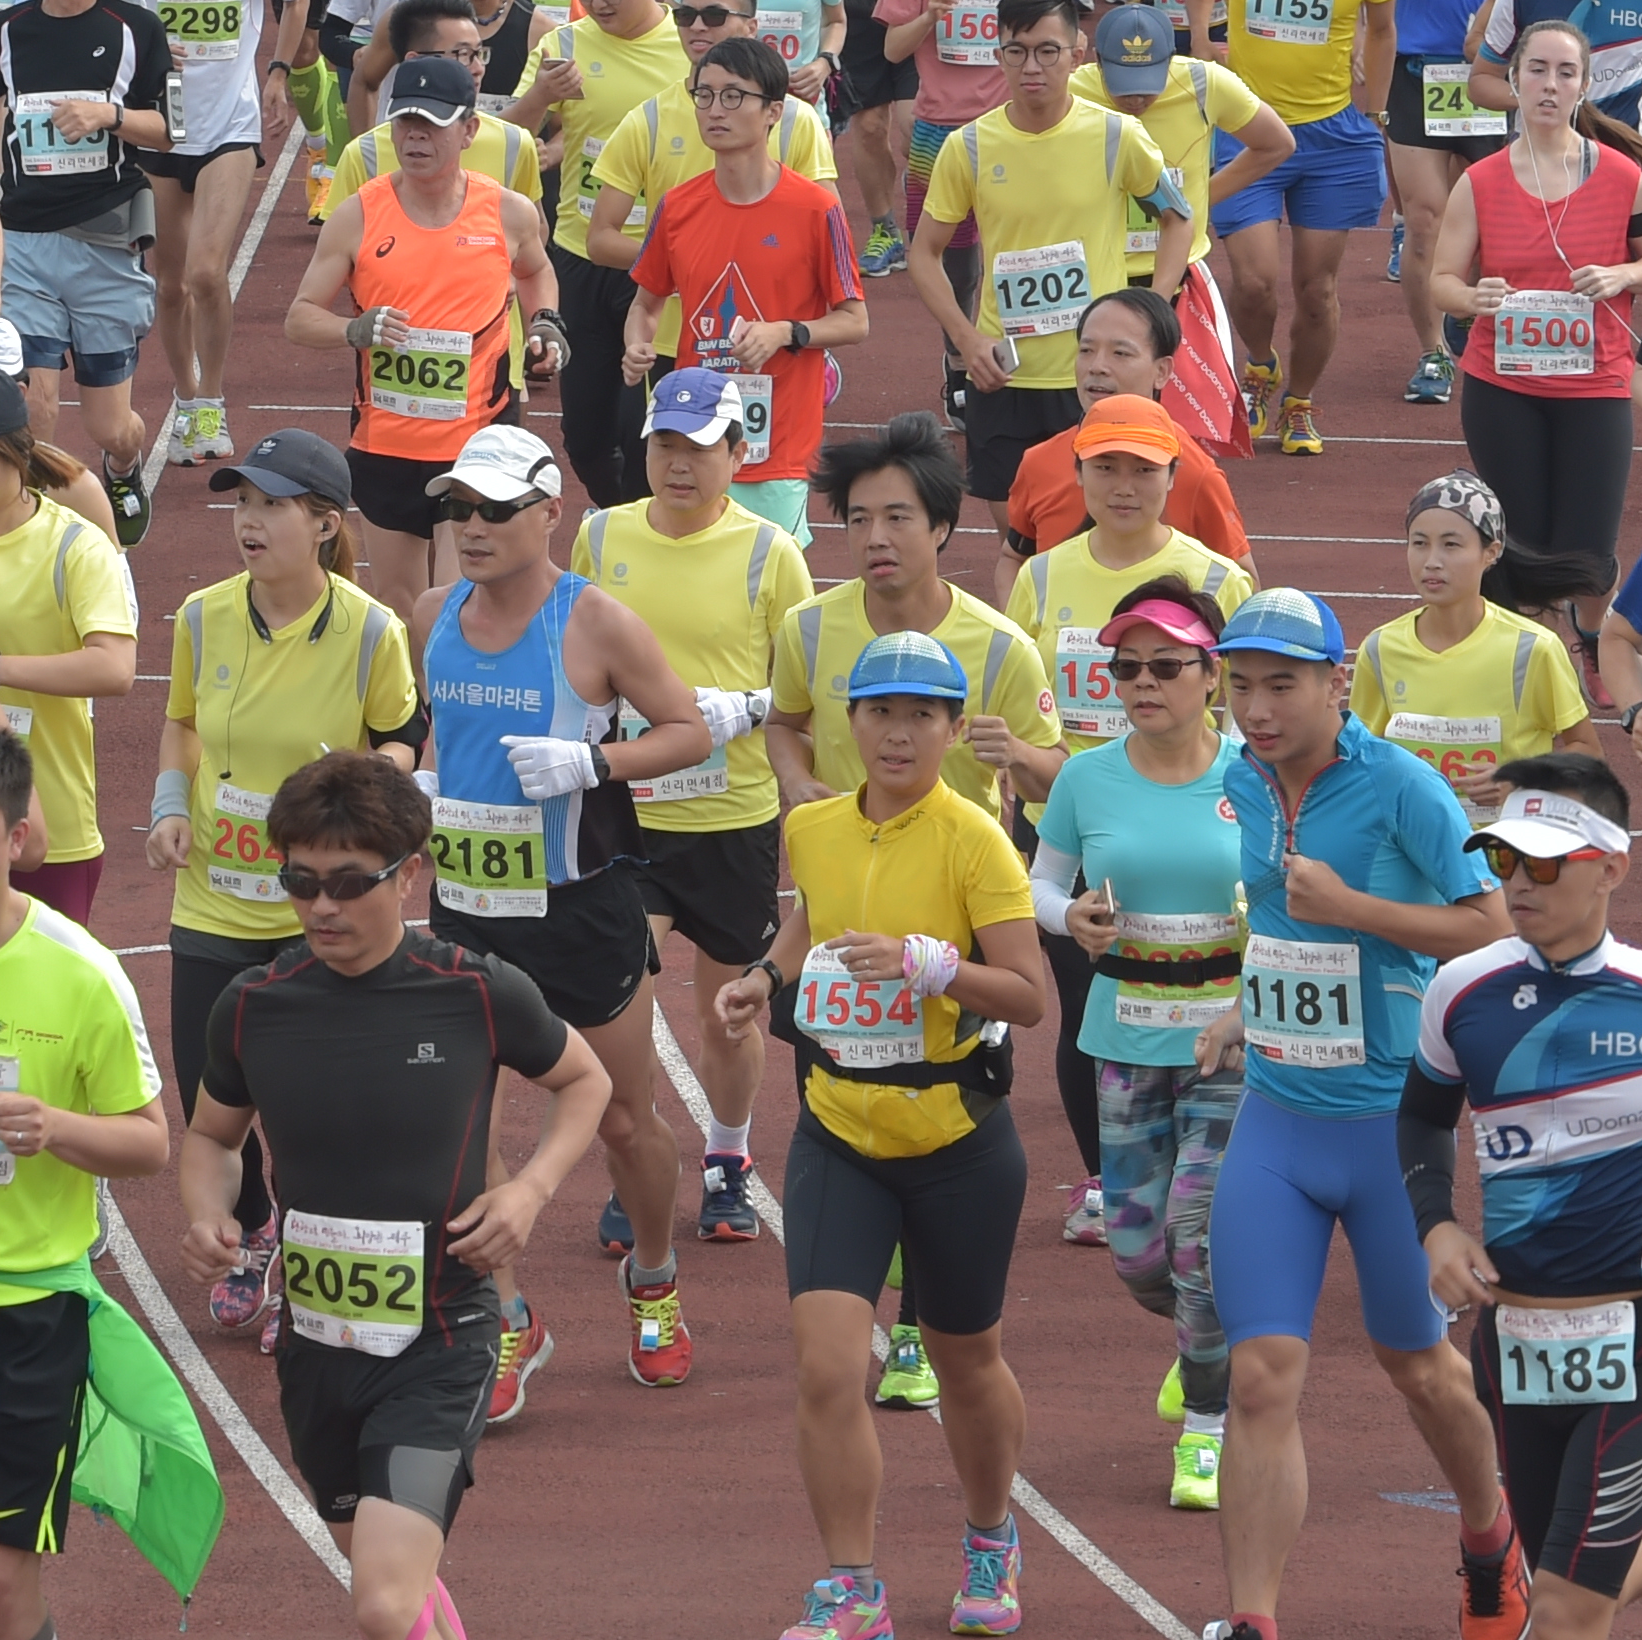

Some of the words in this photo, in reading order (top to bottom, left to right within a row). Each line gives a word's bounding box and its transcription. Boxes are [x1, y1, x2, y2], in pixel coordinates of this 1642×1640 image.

[164, 6, 239, 34] 2298
[58, 155, 106, 170] 신라면세점
[999, 268, 1087, 303] 1202
[1502, 316, 1588, 346] 1500
[373, 351, 465, 388] 2062
[1187, 346, 1201, 364] new
[1200, 362, 1228, 399] balance
[432, 685, 543, 711] 서서울마라톤
[661, 773, 725, 793] 신라면세점
[432, 836, 535, 879] 2181
[803, 982, 917, 1024] 1554
[1249, 979, 1349, 1026] 1181
[848, 1041, 919, 1060] 신라면세점
[1288, 1042, 1358, 1061] 신라면세점
[287, 1253, 416, 1312] 2052
[1508, 1344, 1627, 1392] 1185
